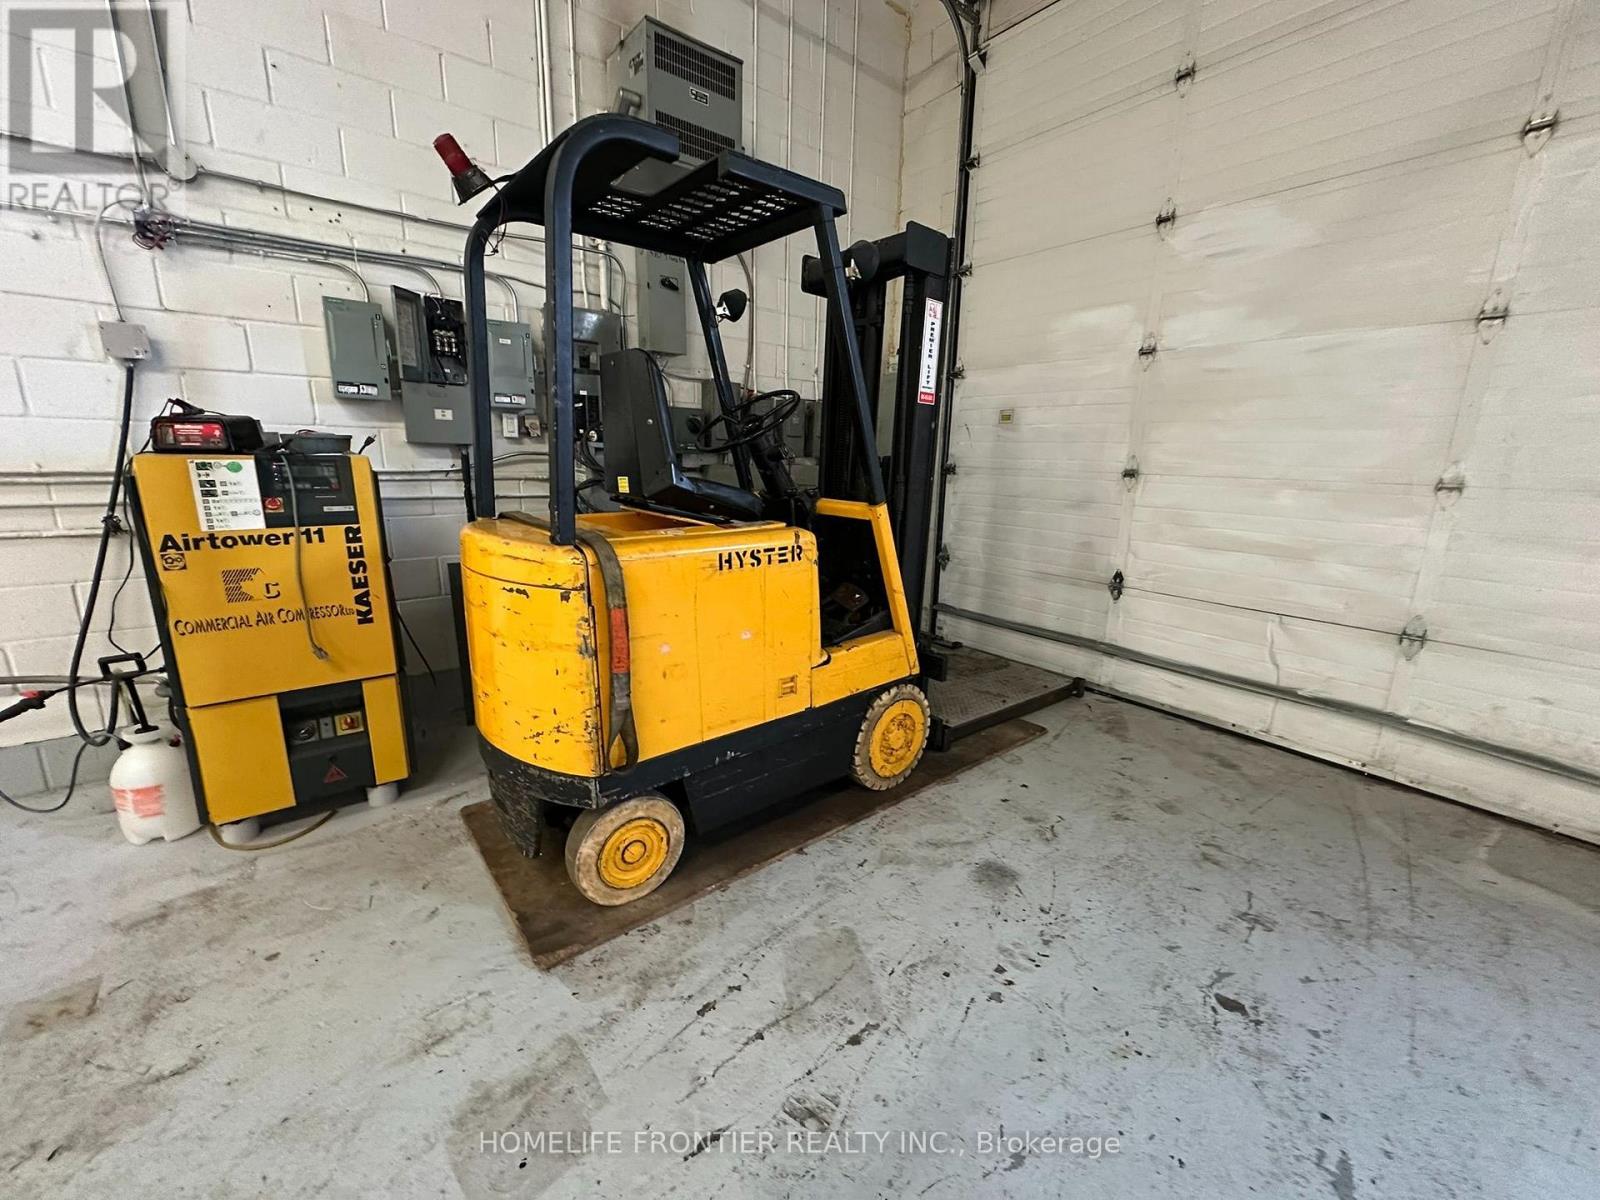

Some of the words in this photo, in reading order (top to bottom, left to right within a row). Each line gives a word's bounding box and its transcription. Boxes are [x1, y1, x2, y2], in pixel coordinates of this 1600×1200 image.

[159, 531, 294, 552] Airtower
[301, 527, 325, 544] 11
[718, 544, 803, 571] HYSTER
[344, 526, 374, 625] KAESER
[174, 616, 252, 636] COMMERCIAL
[256, 611, 276, 626] AIR
[277, 604, 346, 624] COMRESSOR
